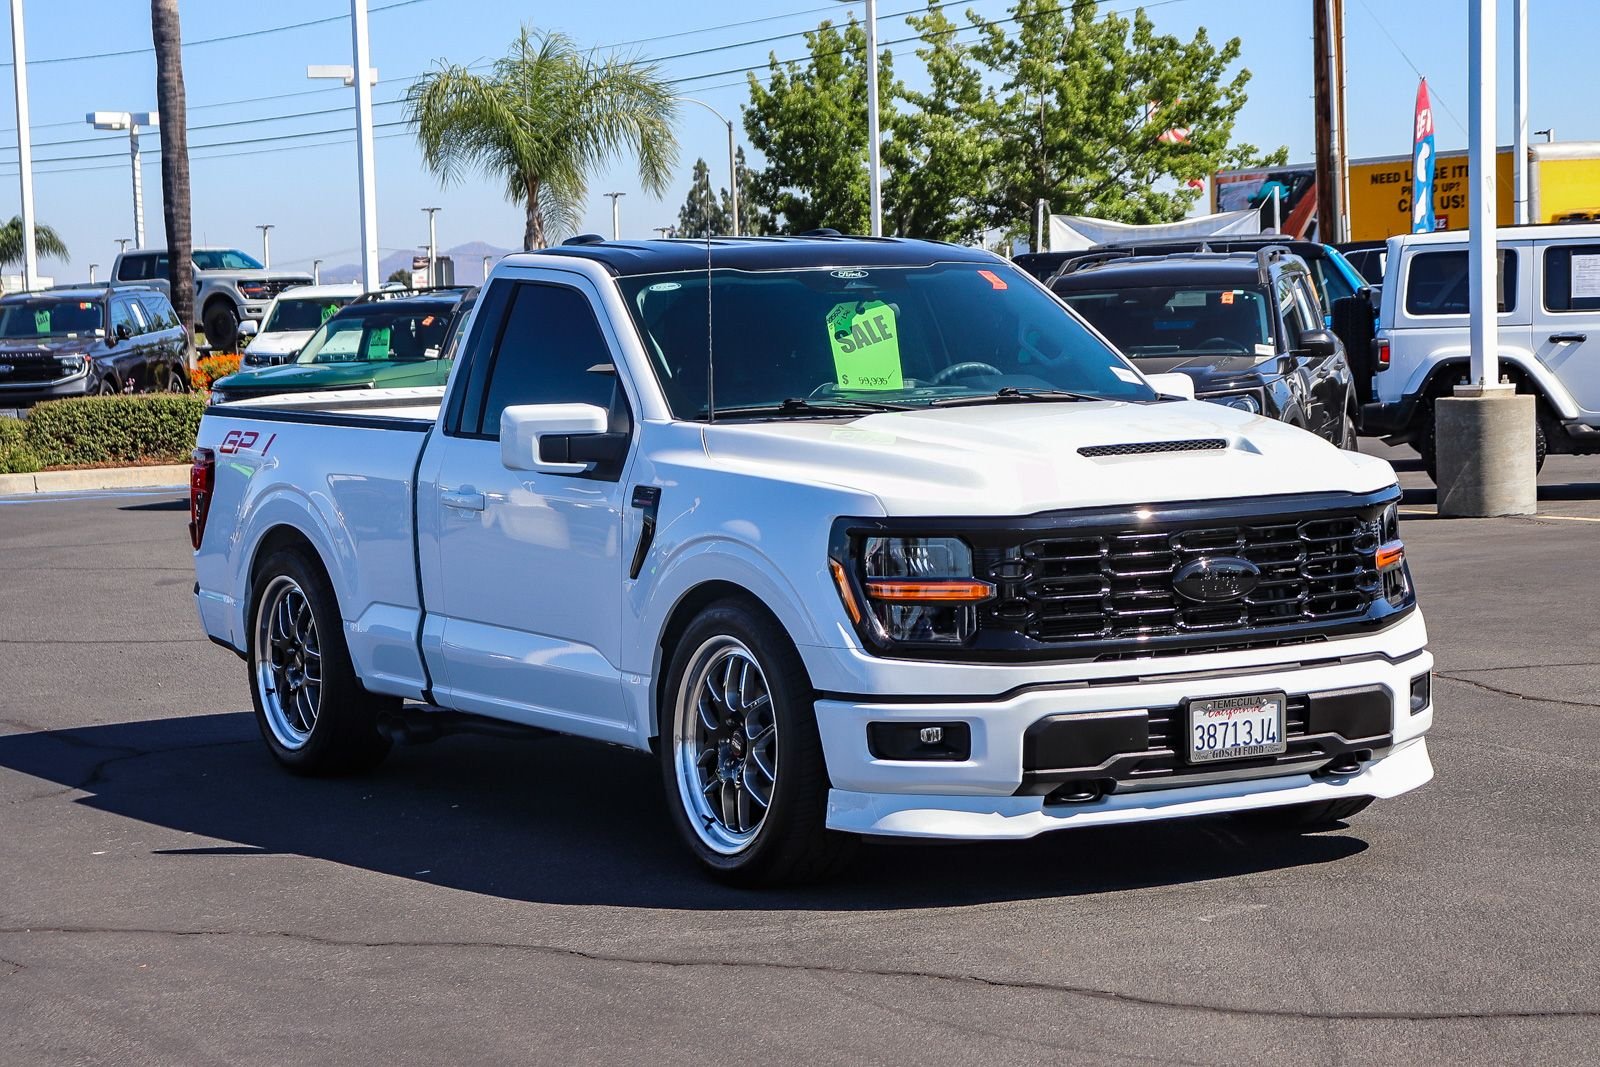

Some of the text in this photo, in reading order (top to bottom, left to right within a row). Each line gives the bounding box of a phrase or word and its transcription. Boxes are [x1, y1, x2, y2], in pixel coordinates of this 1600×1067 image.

[1371, 172, 1401, 185] NEED
[1442, 182, 1460, 193] UP?
[1440, 194, 1465, 210] US!
[836, 270, 864, 278] Ford
[835, 315, 893, 353] SALE
[1212, 697, 1261, 709] TEMECULA
[1195, 717, 1276, 750] 38713J4
[1243, 745, 1264, 756] FORD
